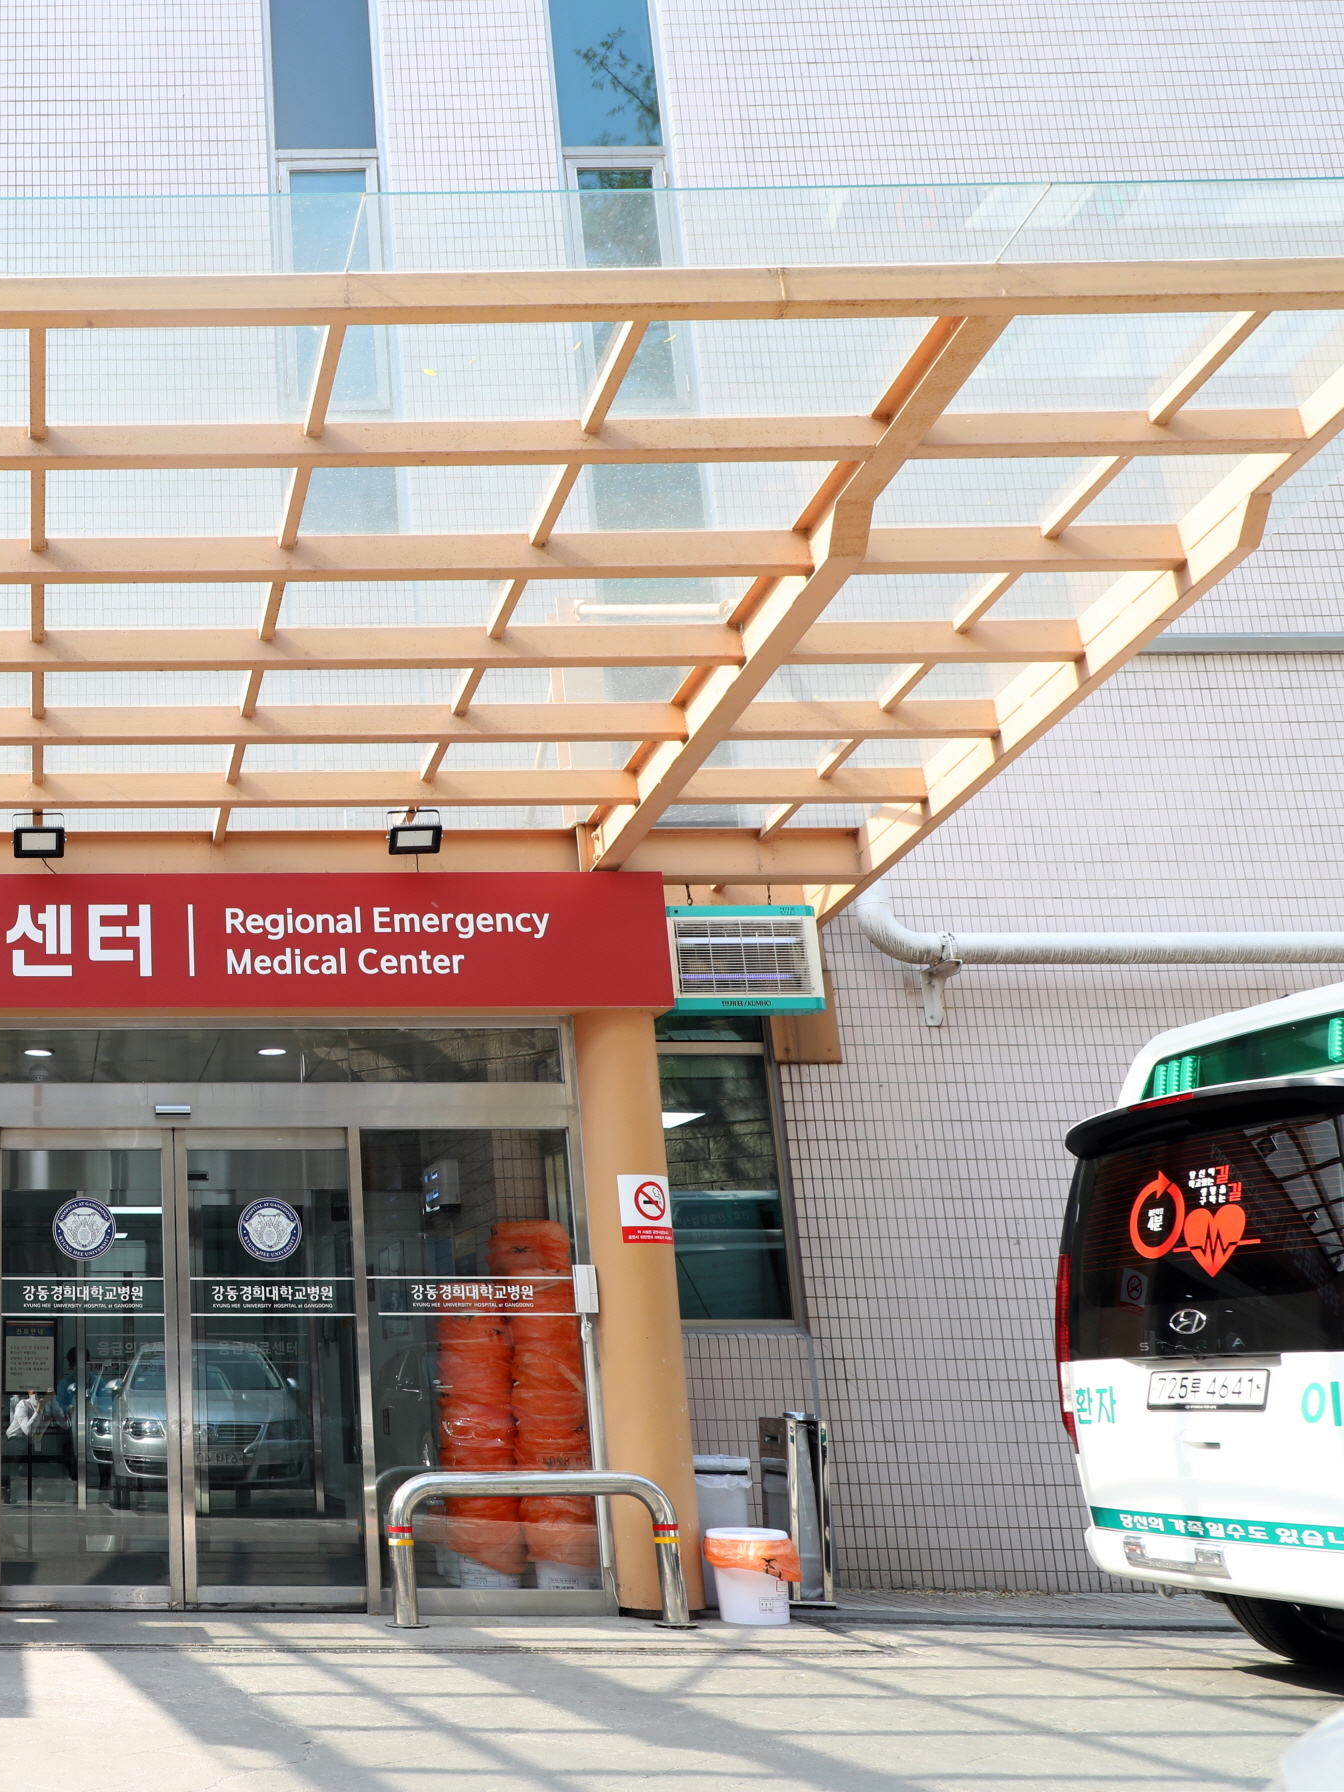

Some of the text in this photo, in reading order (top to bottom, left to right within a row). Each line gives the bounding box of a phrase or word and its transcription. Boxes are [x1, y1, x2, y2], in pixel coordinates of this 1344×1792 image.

[225, 907, 549, 940] Regional Emergency
[226, 948, 465, 975] Medical Center
[1215, 1165, 1230, 1184] 길
[1228, 1182, 1242, 1202] 길
[22, 1285, 144, 1301] 강동경희대학교병원
[211, 1285, 333, 1301] 강동경희대학교병원
[411, 1284, 534, 1300] 강동경희대학교병원
[1206, 1376, 1255, 1399] 4641
[1075, 1386, 1116, 1424] 환자
[1119, 1513, 1165, 1531] 당신의
[1168, 1518, 1269, 1540] 가족일수도
